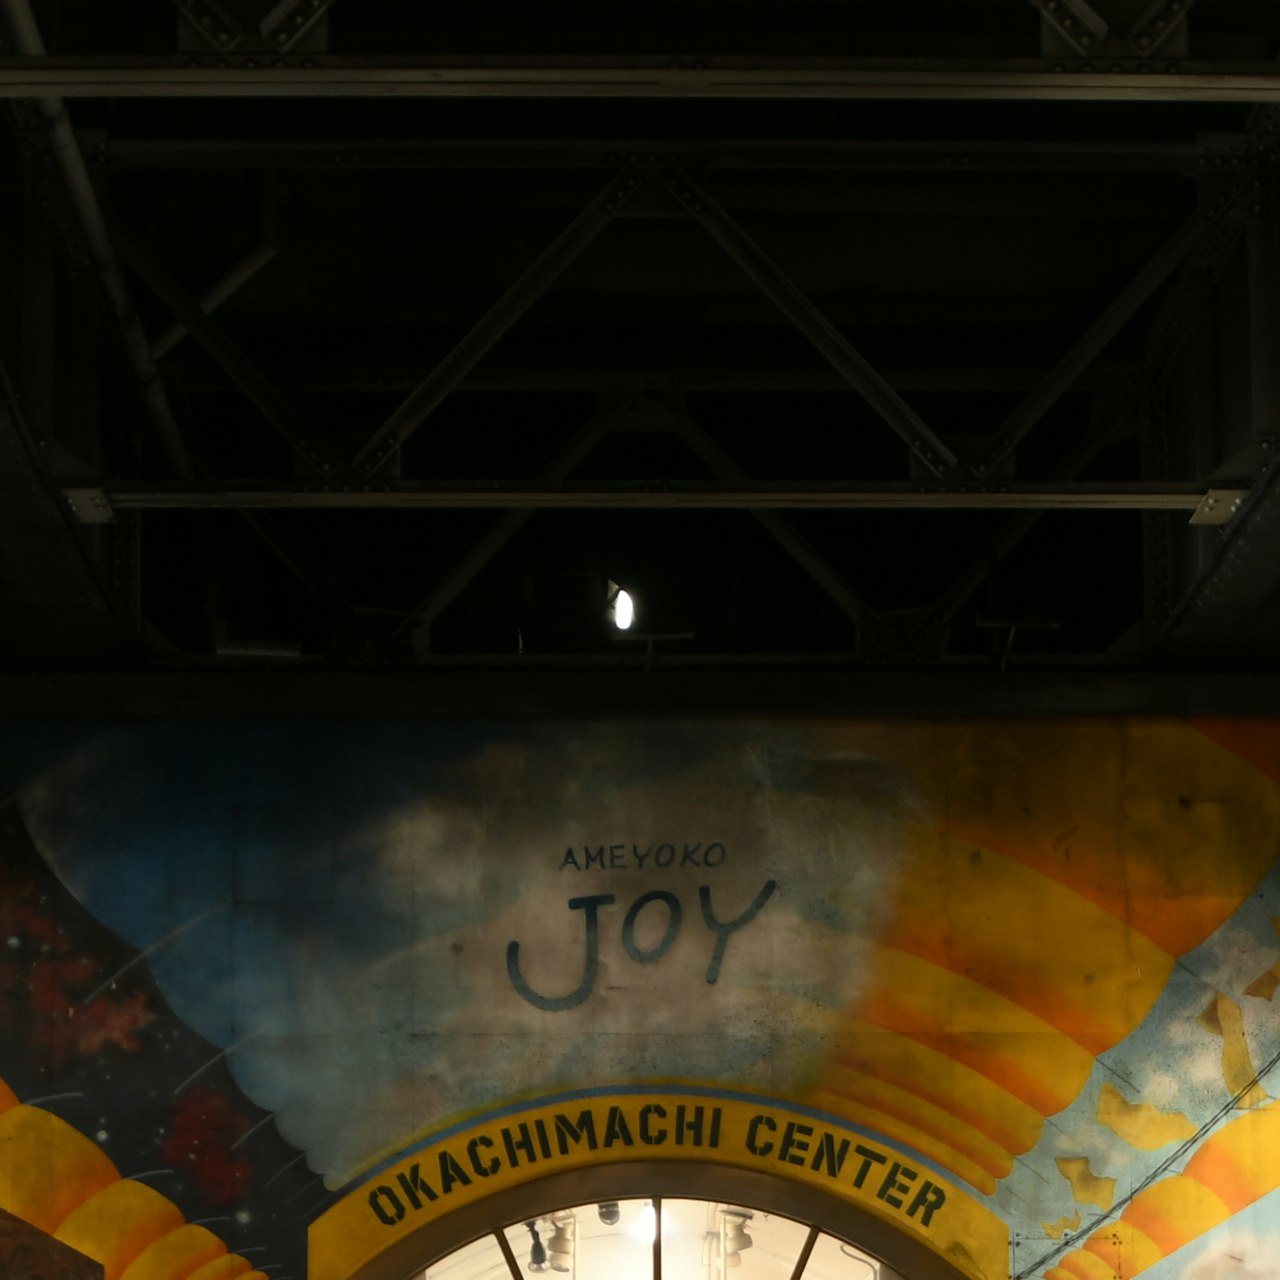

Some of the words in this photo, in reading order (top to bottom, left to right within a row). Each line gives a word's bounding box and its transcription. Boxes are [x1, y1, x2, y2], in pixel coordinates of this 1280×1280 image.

[559, 843, 726, 871] AMEYOKO
[506, 879, 777, 1012] JOY
[368, 1104, 723, 1227] OKACHIMACHI
[745, 1113, 948, 1229] CENTER
